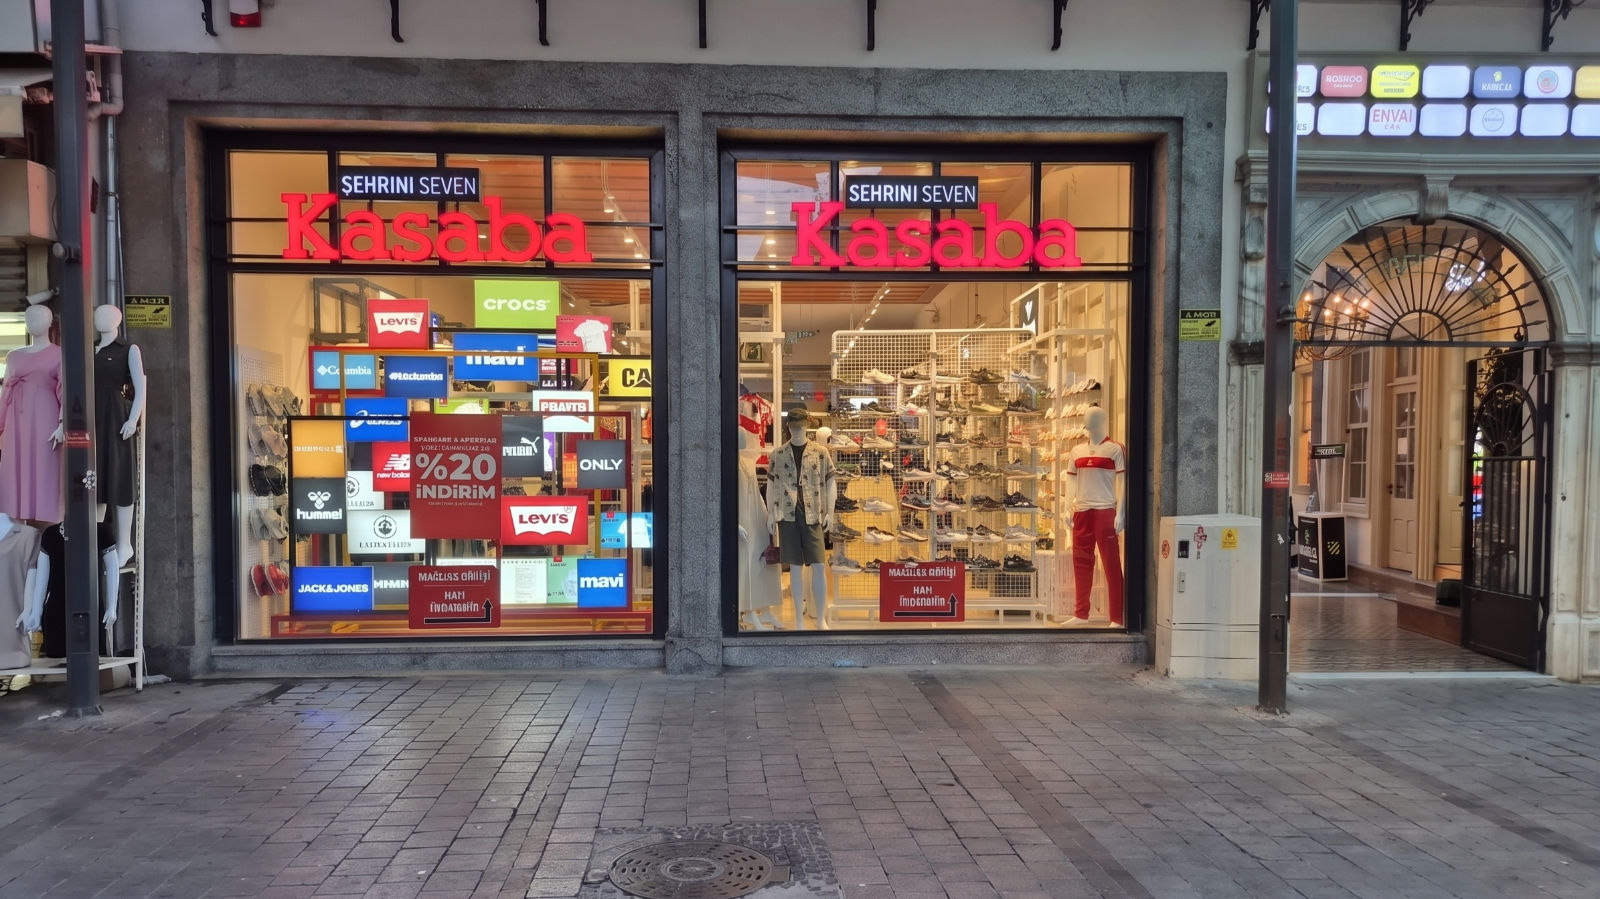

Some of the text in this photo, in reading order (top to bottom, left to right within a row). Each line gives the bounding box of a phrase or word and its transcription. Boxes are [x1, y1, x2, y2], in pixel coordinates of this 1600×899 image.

[419, 176, 476, 196] SEVEN
[922, 184, 976, 203] SEVEN
[281, 193, 593, 263] Kasaba
[791, 201, 1082, 269] Kasaba
[483, 298, 547, 312] crocs
[415, 453, 497, 481] %20
[579, 459, 623, 471] ONLY
[296, 508, 342, 520] hummel
[298, 583, 369, 593] JACK&JONES
[579, 573, 624, 588] mavi
